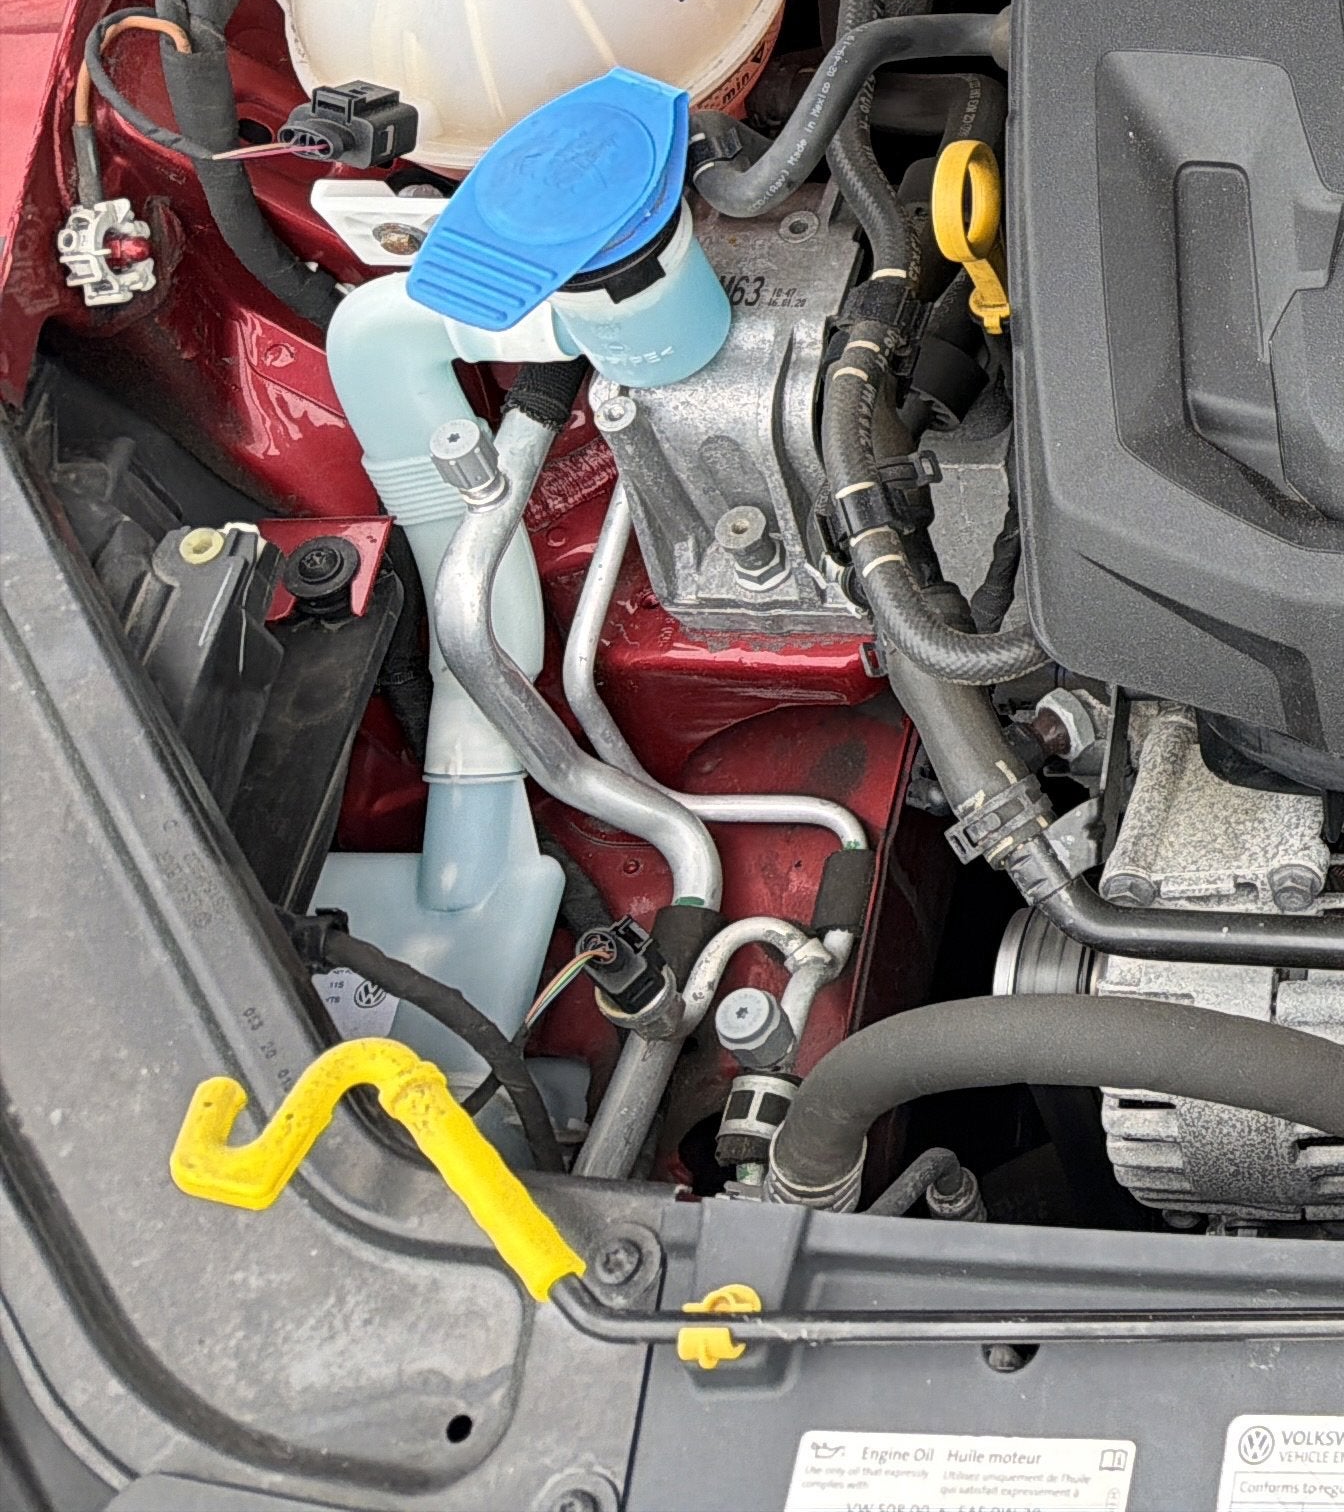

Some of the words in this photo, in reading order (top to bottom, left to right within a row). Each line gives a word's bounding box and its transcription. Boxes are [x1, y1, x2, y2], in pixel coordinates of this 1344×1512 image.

[722, 73, 750, 104] min
[787, 139, 808, 166] Made
[809, 81, 831, 119] Mexico
[862, 1447, 910, 1465] Engine
[914, 1448, 934, 1462] Oil
[947, 1449, 985, 1464] Huile
[988, 1452, 1042, 1465] moteur
[1279, 1451, 1329, 1463] VEHICLE
[863, 1467, 882, 1476] that
[847, 1480, 868, 1490] with
[1047, 1474, 1058, 1483] de
[1240, 1481, 1299, 1494] Conforms
[1303, 1482, 1318, 1494] to
